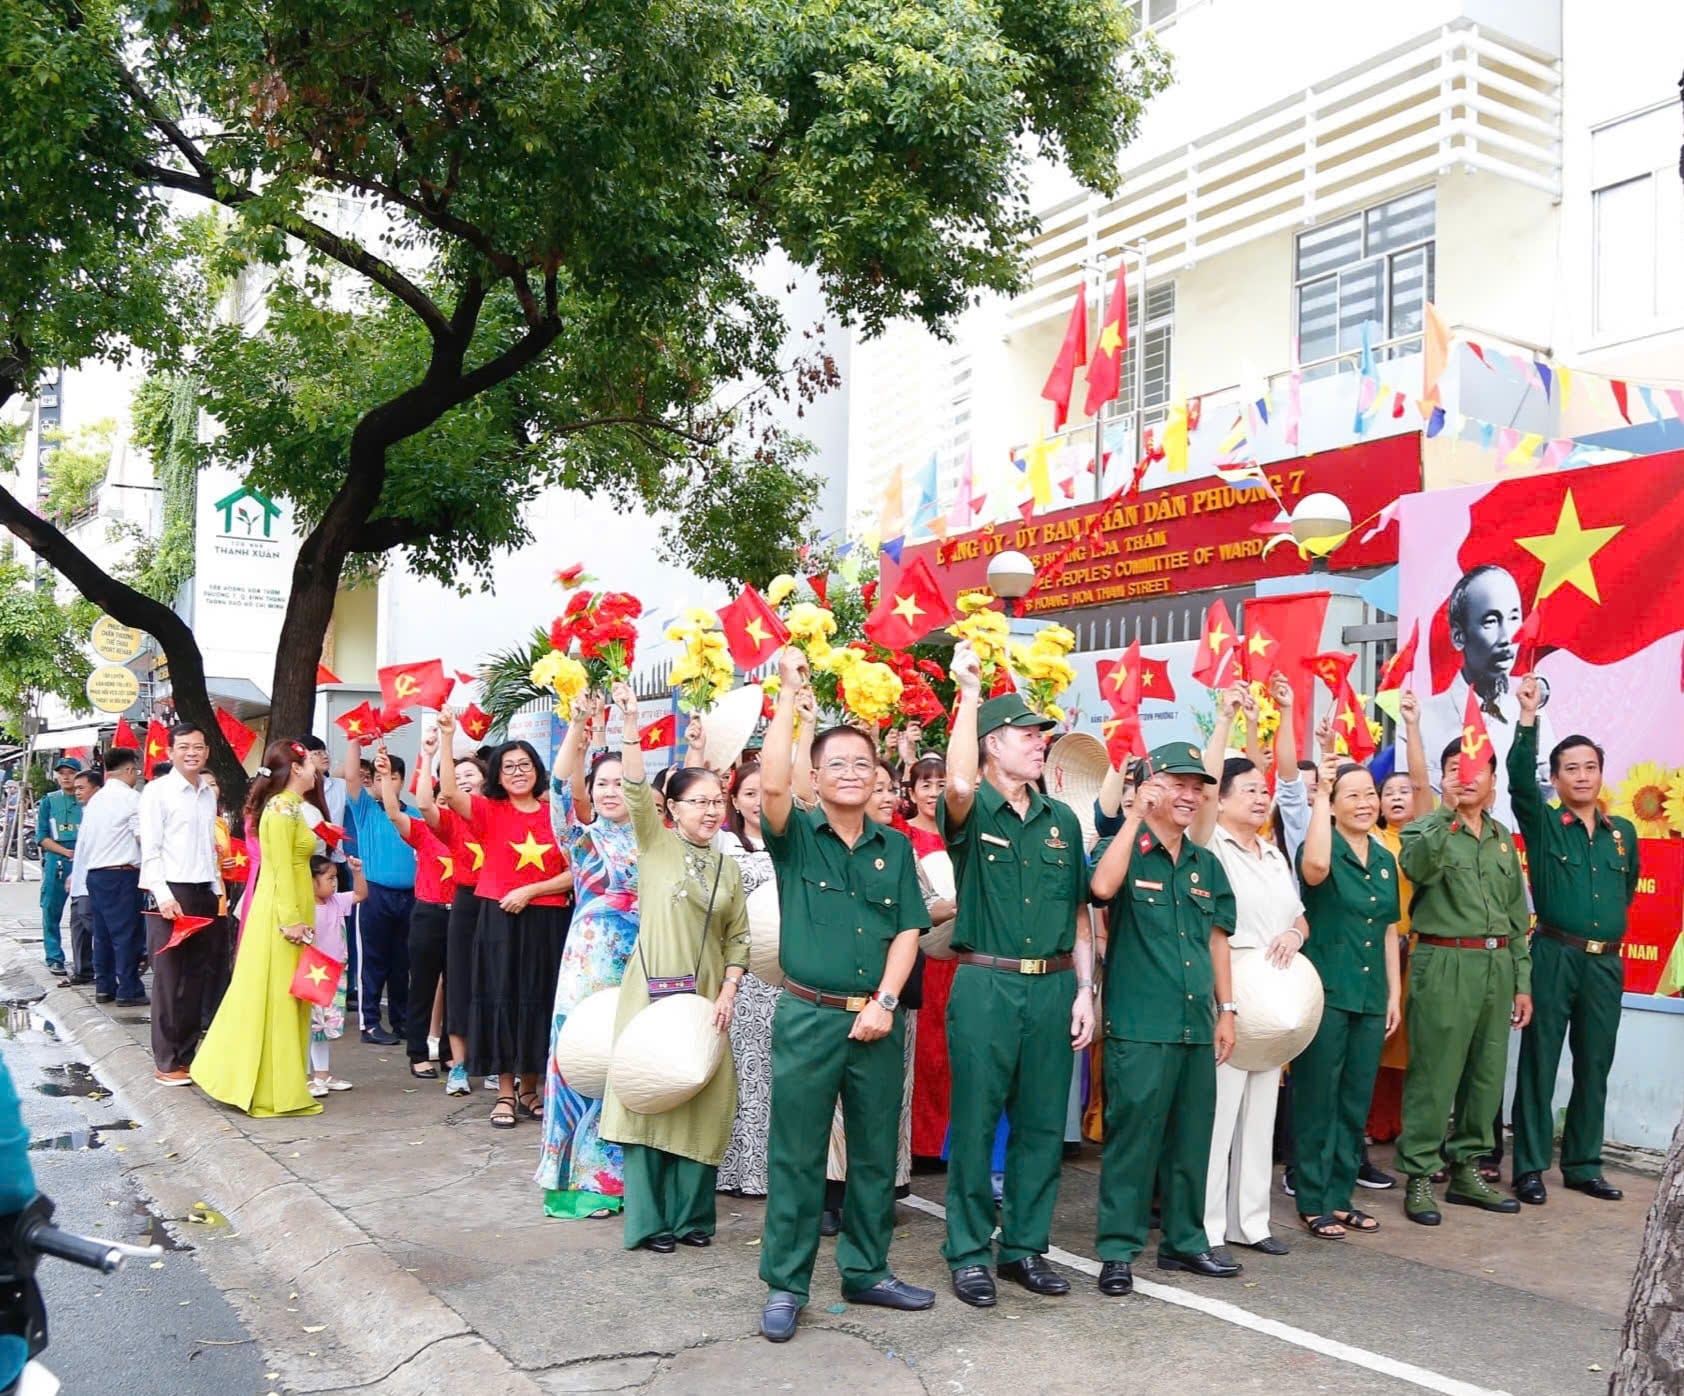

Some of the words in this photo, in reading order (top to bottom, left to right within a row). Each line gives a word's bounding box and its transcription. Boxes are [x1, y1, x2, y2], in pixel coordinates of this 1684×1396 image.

[1043, 517, 1081, 544] BAN
[1143, 491, 1188, 524] DÂN
[1288, 470, 1305, 495] 7
[1123, 528, 1168, 552] THÁM
[1114, 551, 1189, 577] COMMITTEE
[1193, 546, 1215, 565] OF
[1218, 538, 1264, 561] WARD
[1127, 577, 1170, 597] STREET
[1628, 944, 1659, 961] NAM
